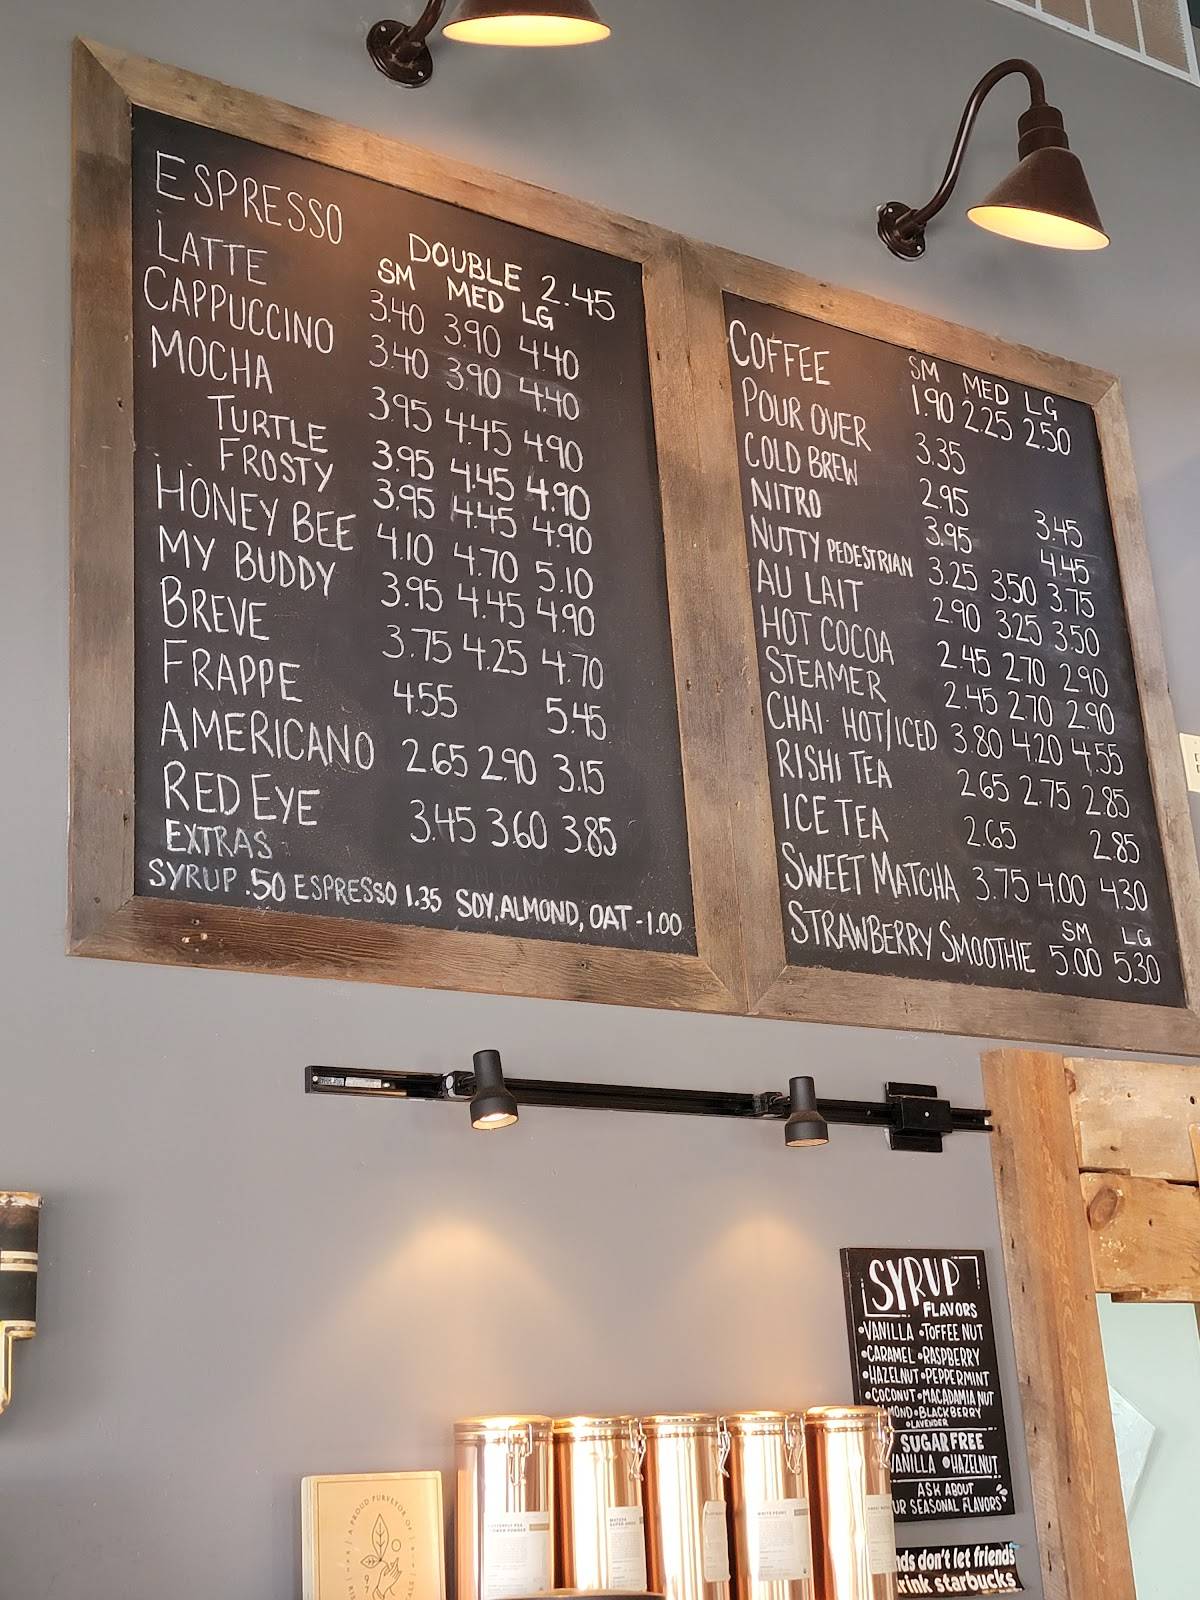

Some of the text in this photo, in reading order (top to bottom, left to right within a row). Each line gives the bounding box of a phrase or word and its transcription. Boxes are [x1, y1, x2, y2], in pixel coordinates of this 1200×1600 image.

[157, 151, 615, 321] ESPRESSO DOUBLE 2.45
[158, 219, 579, 380] LATTE 3.40 3.90 4.40
[378, 258, 554, 330] SM MED LG
[144, 266, 579, 420] CAPPUCCINO 3.40 3.90 4.40
[152, 325, 583, 472] MOCHA 3.95 4.45 4.90
[729, 320, 1070, 455] COFFEE 1.90 2.25 2.50
[908, 356, 1057, 421] SM MED LG
[208, 395, 590, 520] TURTLE 3.95 4.45 4.90
[742, 377, 965, 475] POUR OVER 3.35
[220, 438, 592, 554] FROSTY 3.95 4.45 4.90
[745, 432, 1082, 548] COLD BREW 2.95 3.45
[157, 464, 593, 599] HONEY BEE 4.10 4.70 5.10
[750, 514, 1095, 618] NUTTY PEDESTRIAN 3.25 3.50 3.75
[751, 477, 1089, 584] NITRO 3.95 4.45
[160, 525, 594, 637] MY BUDDY 3.95 4.45 4.90
[758, 559, 1099, 656] AU LAIT 2.90 3.25 3.50
[161, 575, 603, 689] BREVE 3.75 4.25 4.70
[761, 605, 1108, 698] HOT COCOA 2.45 2.70 2.90
[164, 639, 606, 740] FRAPPE 4.55 5.45
[766, 646, 1114, 735] STEAMER 2.45 2.70 2.90
[161, 701, 604, 794] AMERICANO 2.65 2.90 3.15
[842, 707, 937, 751] HOT/ICED
[951, 723, 1002, 759] 3.80
[1012, 729, 1062, 766] 4.20
[1071, 738, 1124, 776] 4.55
[163, 761, 240, 815] RED
[252, 774, 320, 825] EYE
[410, 800, 476, 843] 3.45
[562, 816, 616, 857] 3.85
[776, 739, 841, 783] RISHI
[849, 751, 892, 788] TEA
[1019, 775, 1071, 810] 2.75
[1082, 785, 1129, 818] 2.85
[166, 819, 272, 859] EXTRAS
[783, 793, 1140, 864] ICE TEA 2.65 2.85
[149, 858, 237, 892] SYRUP
[245, 868, 285, 901] .50
[295, 874, 397, 905] ESPRESSO
[406, 884, 441, 912] 1.35
[590, 904, 632, 931] OAT
[781, 842, 1147, 911] SWEET MATCHA 3.75 4.00 4.30
[788, 900, 1161, 984] STRAWBERRY SMOOTHIE 5.00 5.30
[1062, 920, 1151, 946] SM LG
[869, 1257, 959, 1311] SYRUP
[923, 1301, 977, 1318] FLAVORS
[863, 1321, 984, 1341] VANILLA TOFFEE NUT
[867, 1345, 980, 1367] CARAMEL RASPBERRY
[868, 1365, 989, 1386] HAZELNUT PEPPERMINT
[872, 1388, 994, 1408] COCONUT MACADAMIA NUT
[878, 1404, 981, 1419] MOND BLACKBERRY
[900, 1432, 984, 1453] SUGAR FREE
[911, 1419, 948, 1428] LAVENDER
[918, 1482, 974, 1497] ASK ABOUT
[951, 1455, 998, 1475] HAZELNUT
[350, 1498, 370, 1526] PROUD
[892, 1496, 1002, 1515] UR SEASONAL FLAVORS
[897, 1569, 1016, 1594] rink starbucks
[918, 1549, 950, 1570] don't
[953, 1547, 970, 1569] let
[974, 1544, 1015, 1567] friends
